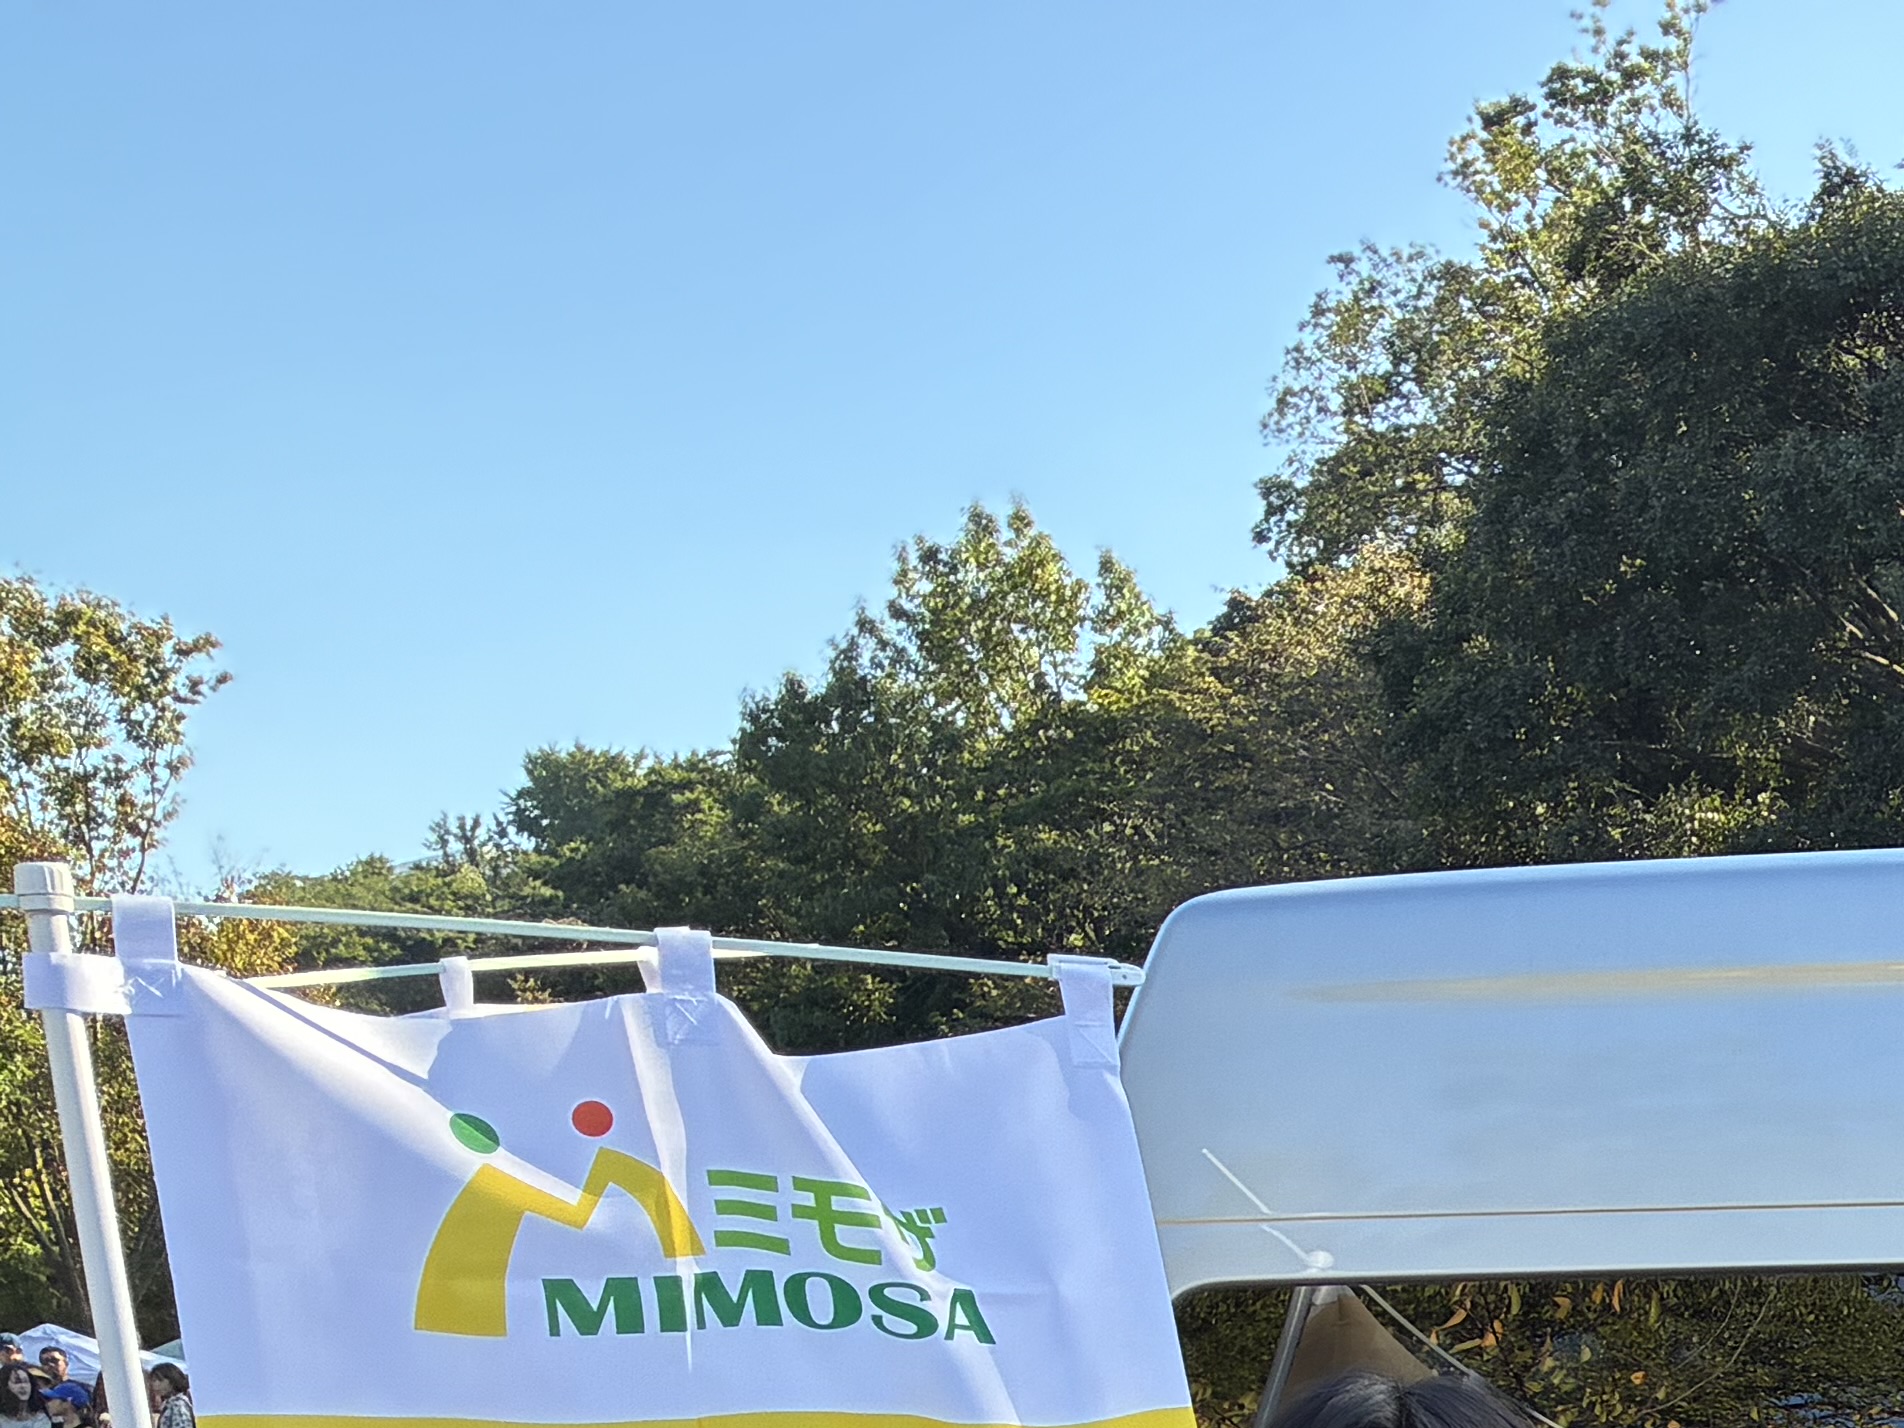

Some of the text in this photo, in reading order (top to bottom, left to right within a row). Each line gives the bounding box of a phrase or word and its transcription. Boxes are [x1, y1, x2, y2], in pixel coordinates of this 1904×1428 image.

[708, 1168, 948, 1273] ミモザ
[545, 1264, 994, 1346] MIMOSA
